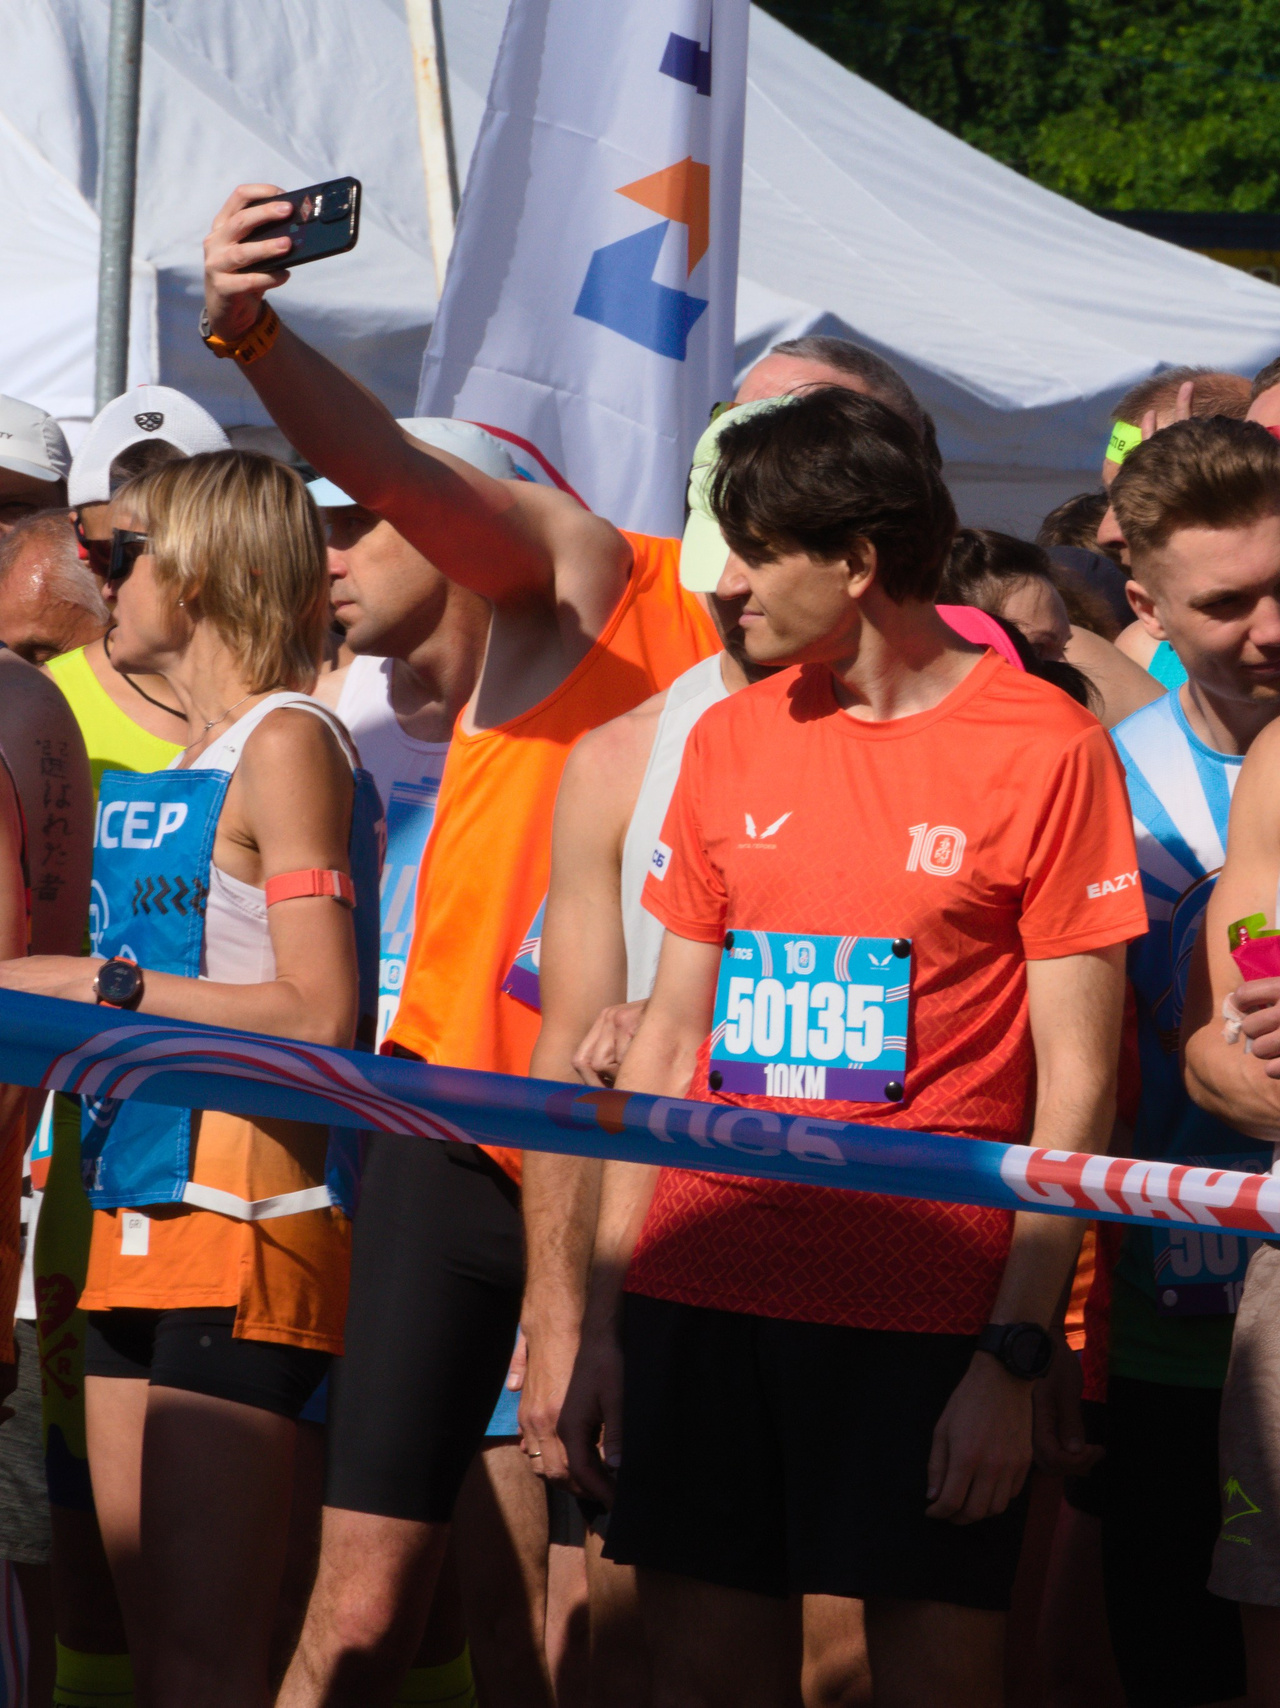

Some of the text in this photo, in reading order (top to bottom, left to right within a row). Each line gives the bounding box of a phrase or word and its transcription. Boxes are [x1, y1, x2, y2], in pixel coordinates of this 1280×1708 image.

[905, 822, 967, 877] 10
[1086, 870, 1139, 900] EAZY
[784, 940, 816, 975] 10
[724, 976, 885, 1063] 50135
[764, 1063, 827, 1100] 10KM
[647, 1097, 849, 1167] ПСБ
